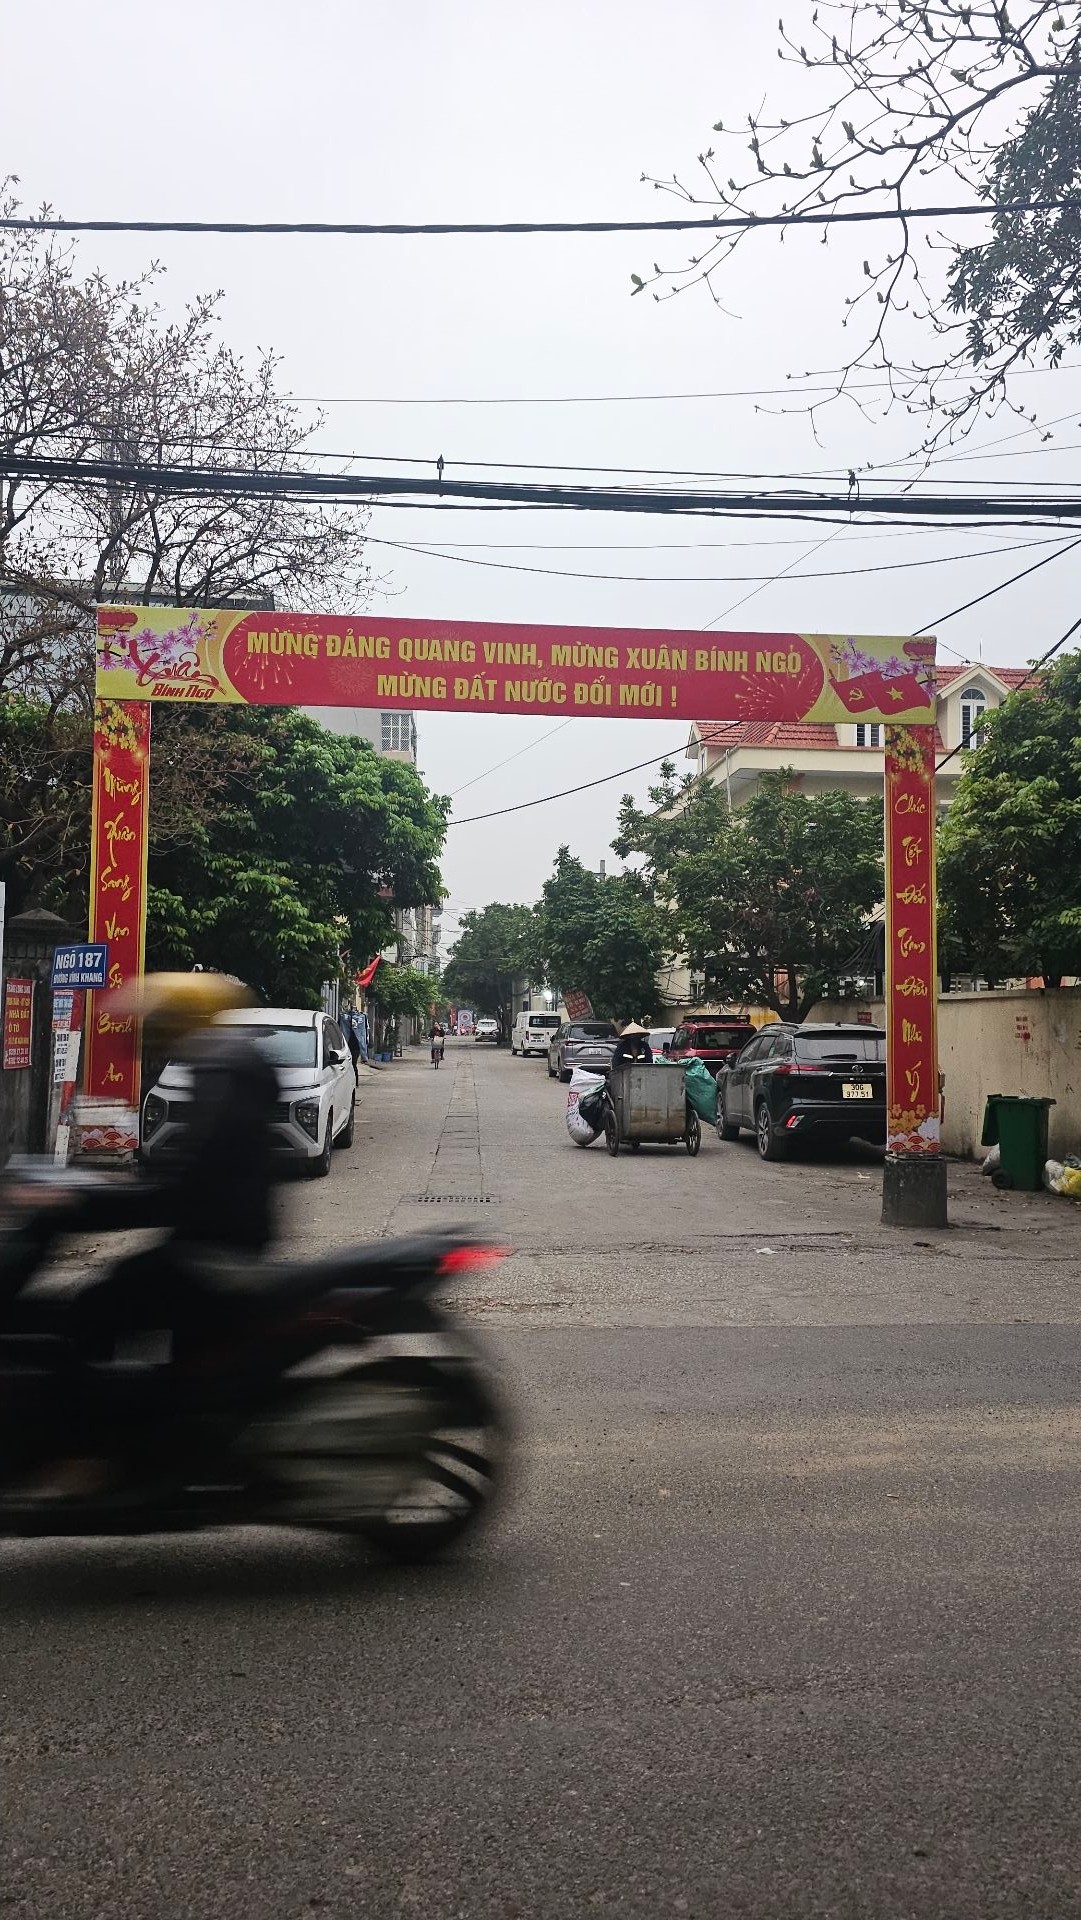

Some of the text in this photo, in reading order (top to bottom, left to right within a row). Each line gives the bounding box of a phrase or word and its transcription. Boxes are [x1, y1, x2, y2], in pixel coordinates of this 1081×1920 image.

[247, 628, 802, 678] MỪNG ĐẢNG QUANG VINH, MỪNG XUÂN BÍNH NGỌ
[377, 671, 677, 708] MỪNG ĐẤT NƯỚC ĐỔI MỚI !
[103, 767, 142, 806] Mừng
[895, 793, 928, 815] Chúc
[104, 812, 136, 867] Xuân
[902, 836, 923, 867] Tết
[101, 866, 136, 901] Sang
[896, 882, 927, 905] Đến
[105, 912, 130, 942] Vạn
[55, 950, 103, 970] NGÕ 187
[80, 972, 103, 983] KHANG
[905, 1060, 922, 1102] Ý
